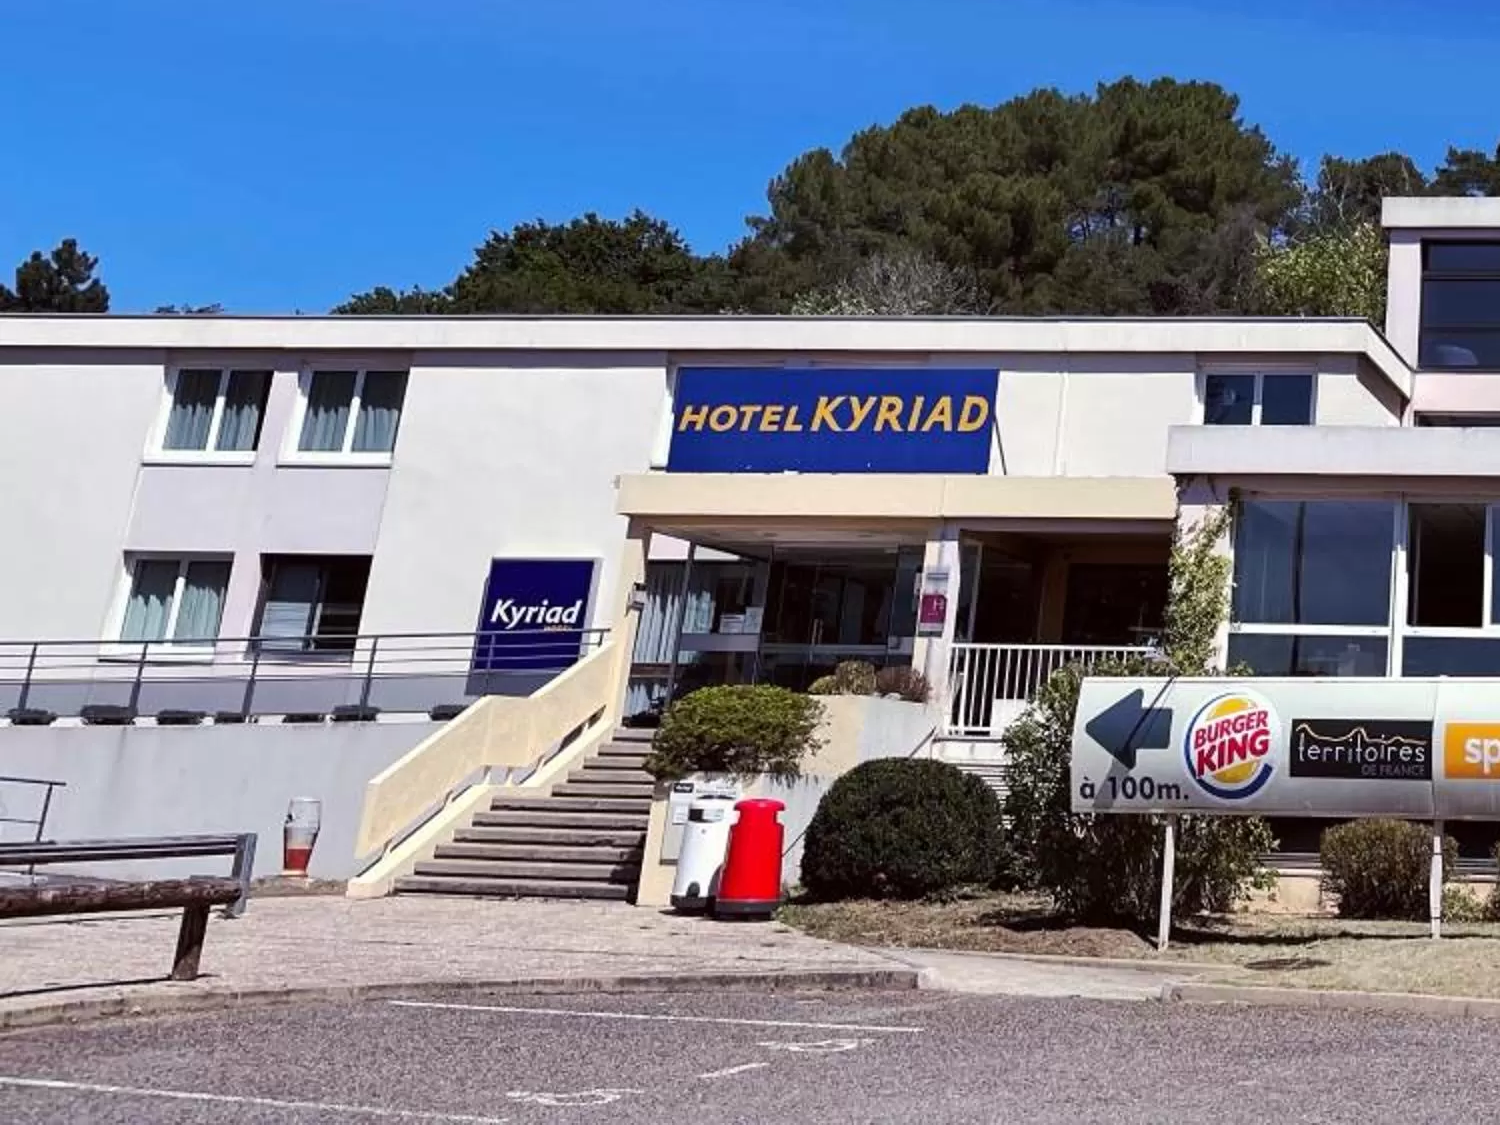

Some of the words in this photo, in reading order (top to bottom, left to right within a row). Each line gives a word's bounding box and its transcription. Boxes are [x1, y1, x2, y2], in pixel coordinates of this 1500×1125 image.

[679, 405, 803, 431] HOTEL
[811, 395, 989, 431] KYRIAD
[490, 598, 583, 629] Kyriad
[1194, 710, 1268, 748] BURGER
[1197, 730, 1270, 777] KING
[1298, 733, 1426, 763] territoires
[1080, 775, 1095, 800] à
[1107, 776, 1189, 801] 100m.
